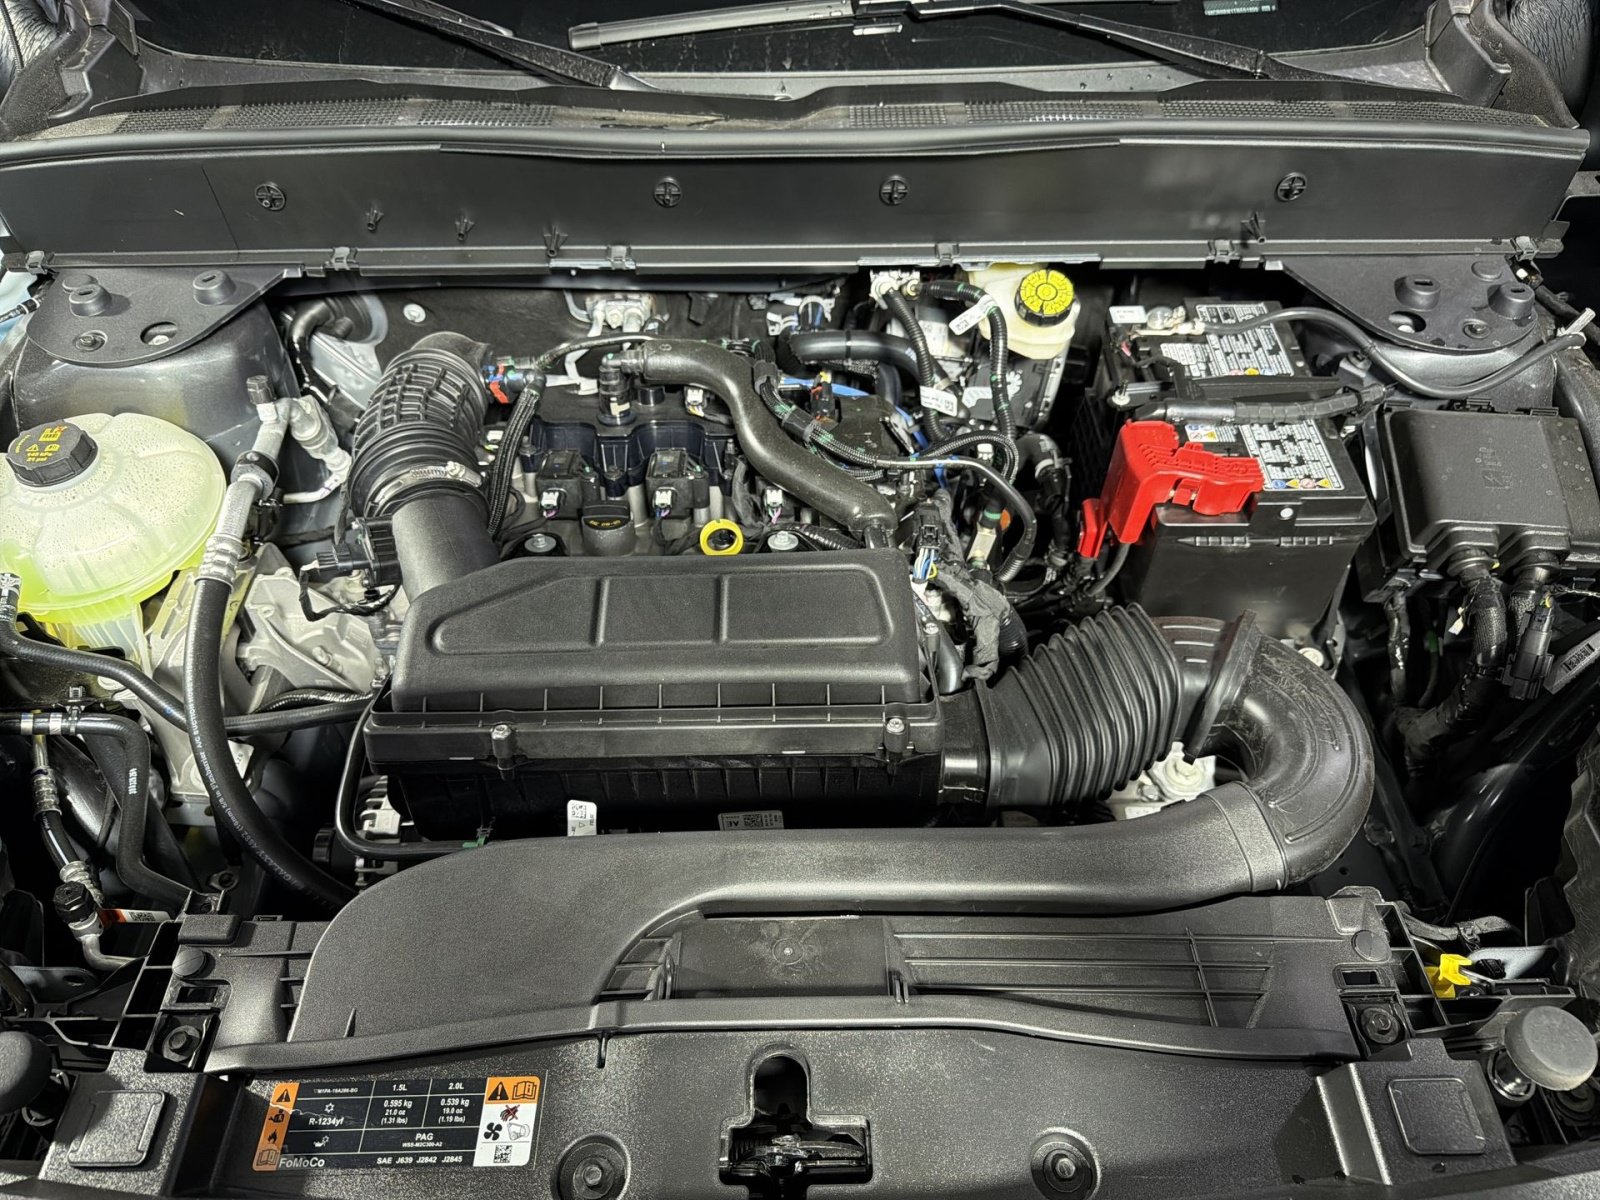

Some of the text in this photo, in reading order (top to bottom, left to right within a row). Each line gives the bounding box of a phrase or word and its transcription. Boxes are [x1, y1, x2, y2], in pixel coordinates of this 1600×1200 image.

[189, 703, 199, 735] SUCTION
[194, 736, 202, 748] A/C
[200, 752, 219, 790] Flexbarrier
[256, 850, 292, 881] GALAXY
[448, 1082, 464, 1090] 2.0L
[383, 1098, 470, 1109] 0.595 kg 0.539 kg
[308, 1117, 345, 1127] R-1234yf
[396, 1116, 408, 1124] lbs)
[453, 1115, 466, 1123] lbs)
[415, 1133, 434, 1141] PAG
[279, 1157, 325, 1168] FoMoCo
[416, 1156, 437, 1164] J2842
[441, 1155, 463, 1163] J2845
